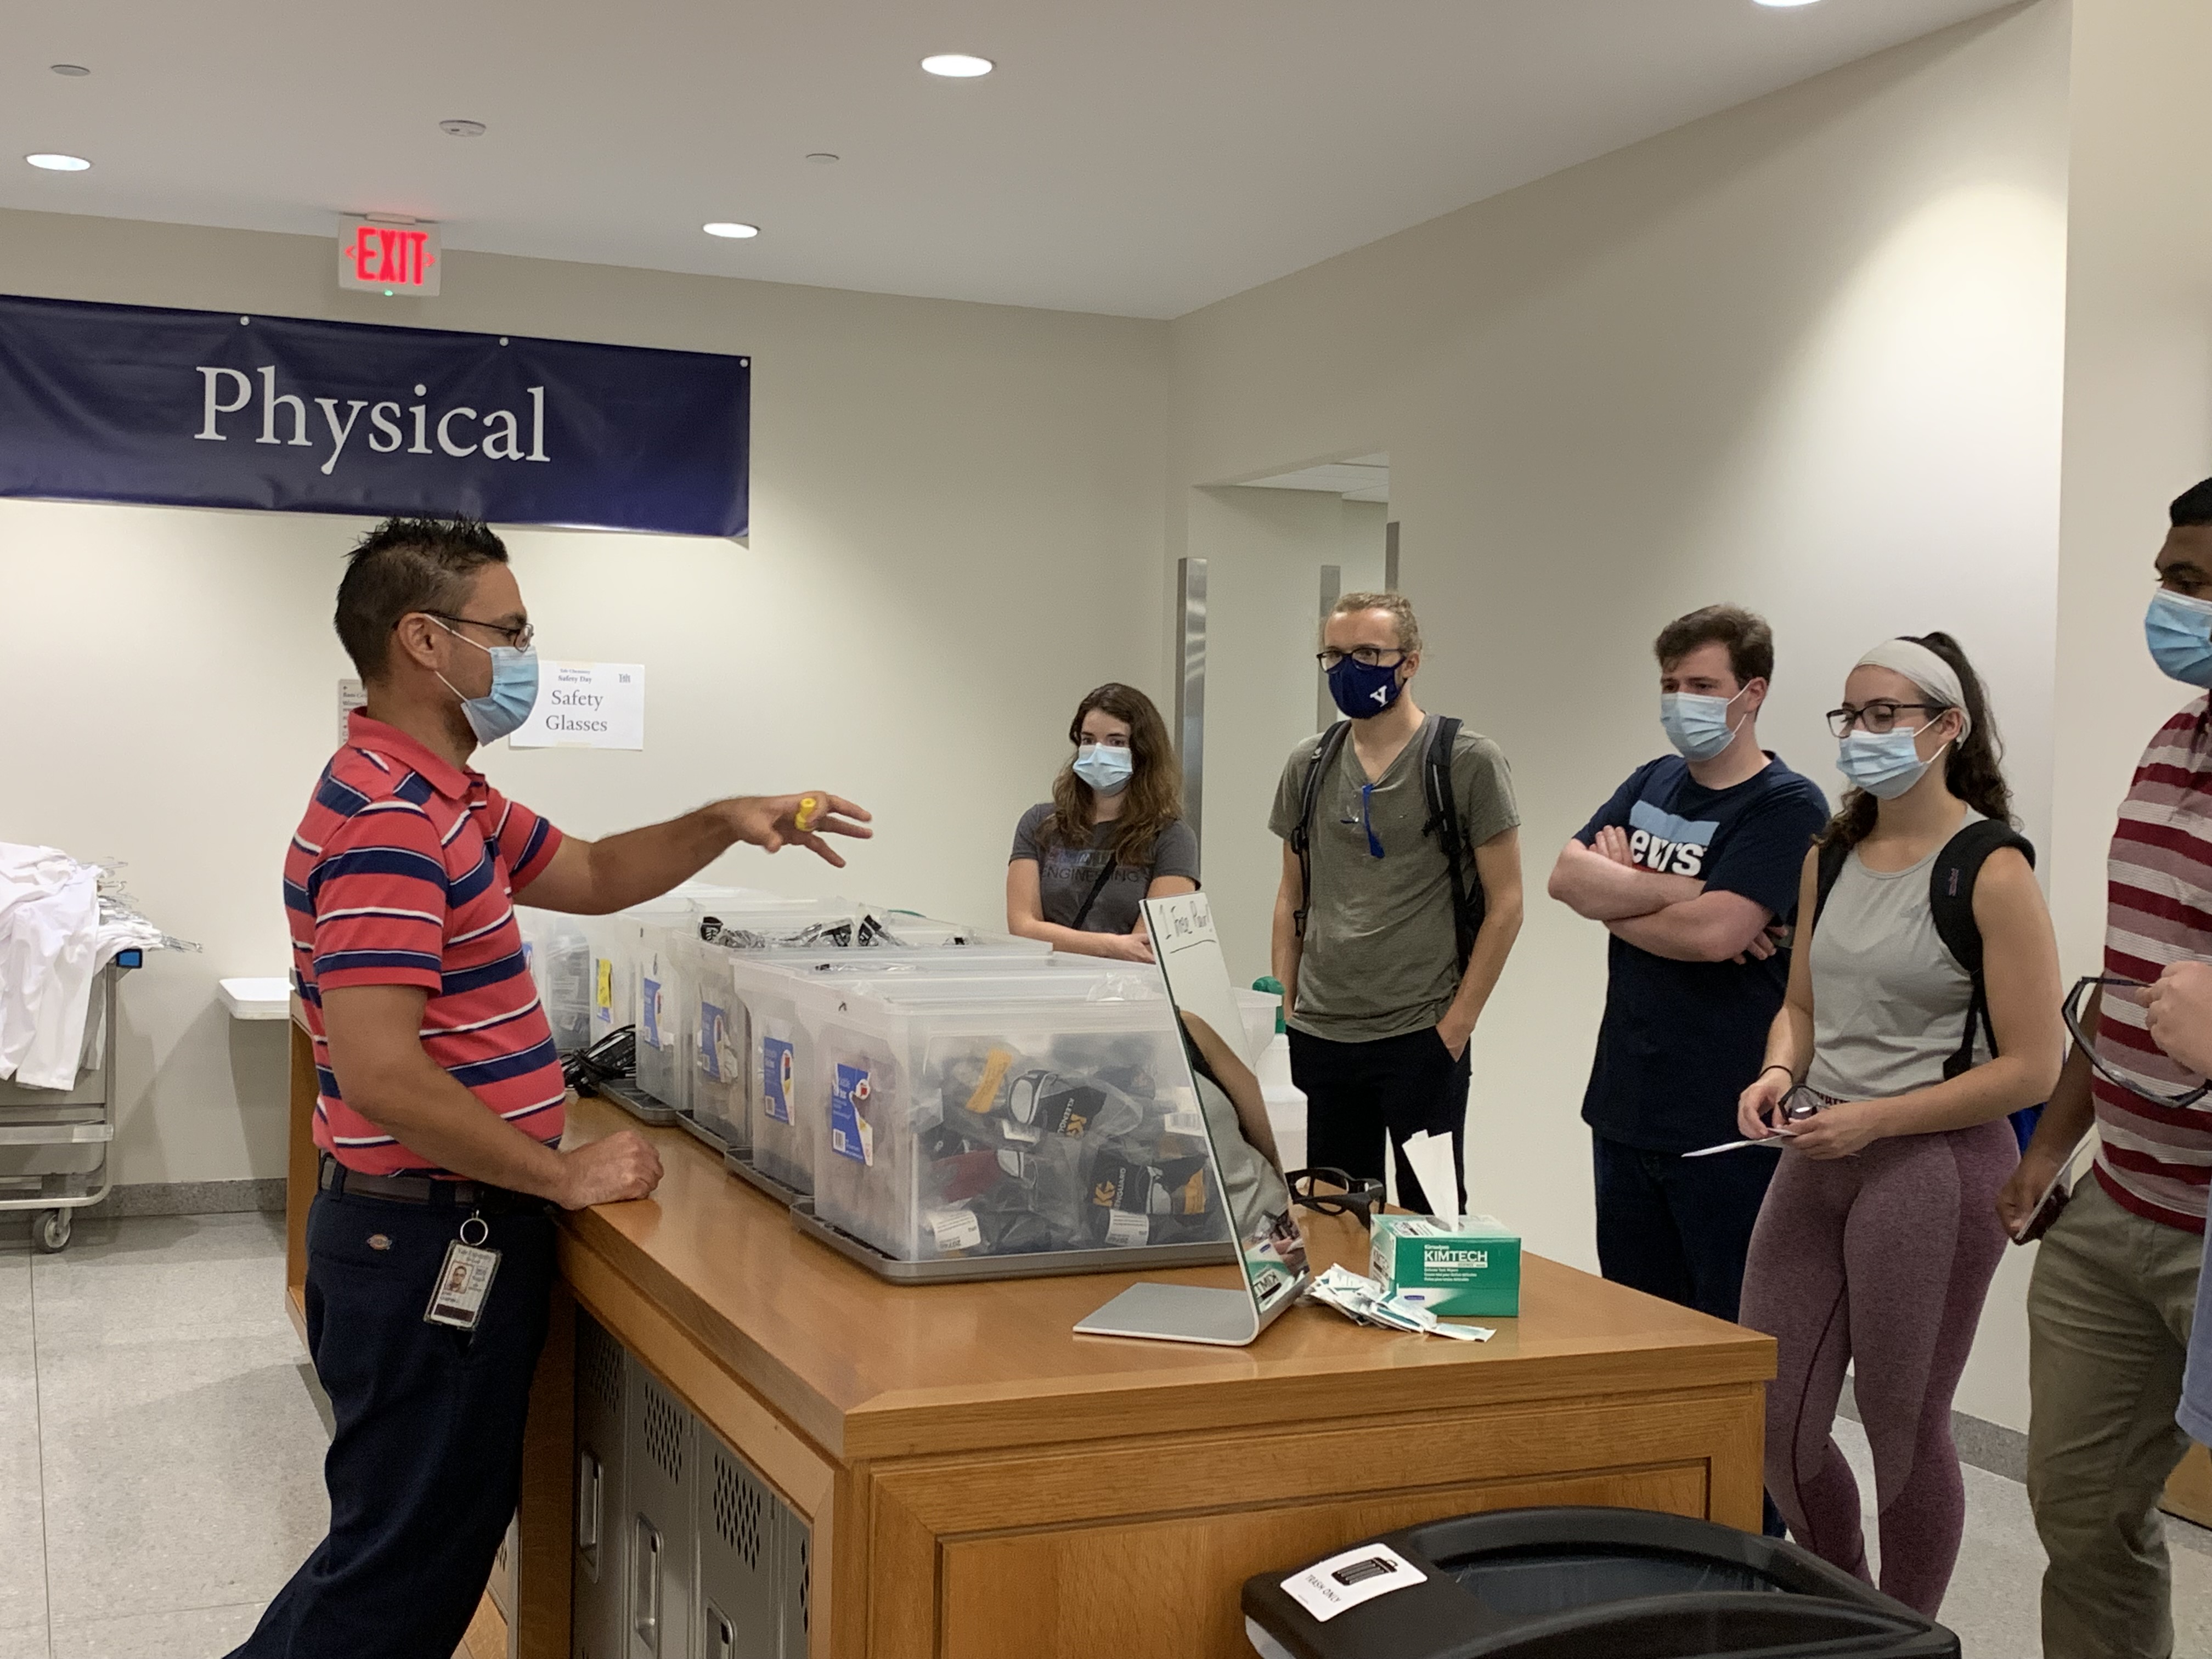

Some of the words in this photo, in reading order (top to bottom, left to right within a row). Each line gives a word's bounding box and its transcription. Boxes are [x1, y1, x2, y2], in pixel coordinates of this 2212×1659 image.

[356, 226, 428, 286] EXIT
[194, 365, 550, 475] Physical
[558, 675, 578, 684] Safety
[580, 676, 592, 684] Day
[551, 690, 603, 712] Safety
[1369, 685, 1389, 707] Y
[546, 714, 607, 732] Glasses
[1424, 1250, 1488, 1262] KIMTECH
[1305, 1573, 1326, 1591] TRASH
[1322, 1588, 1342, 1604] ONLY
